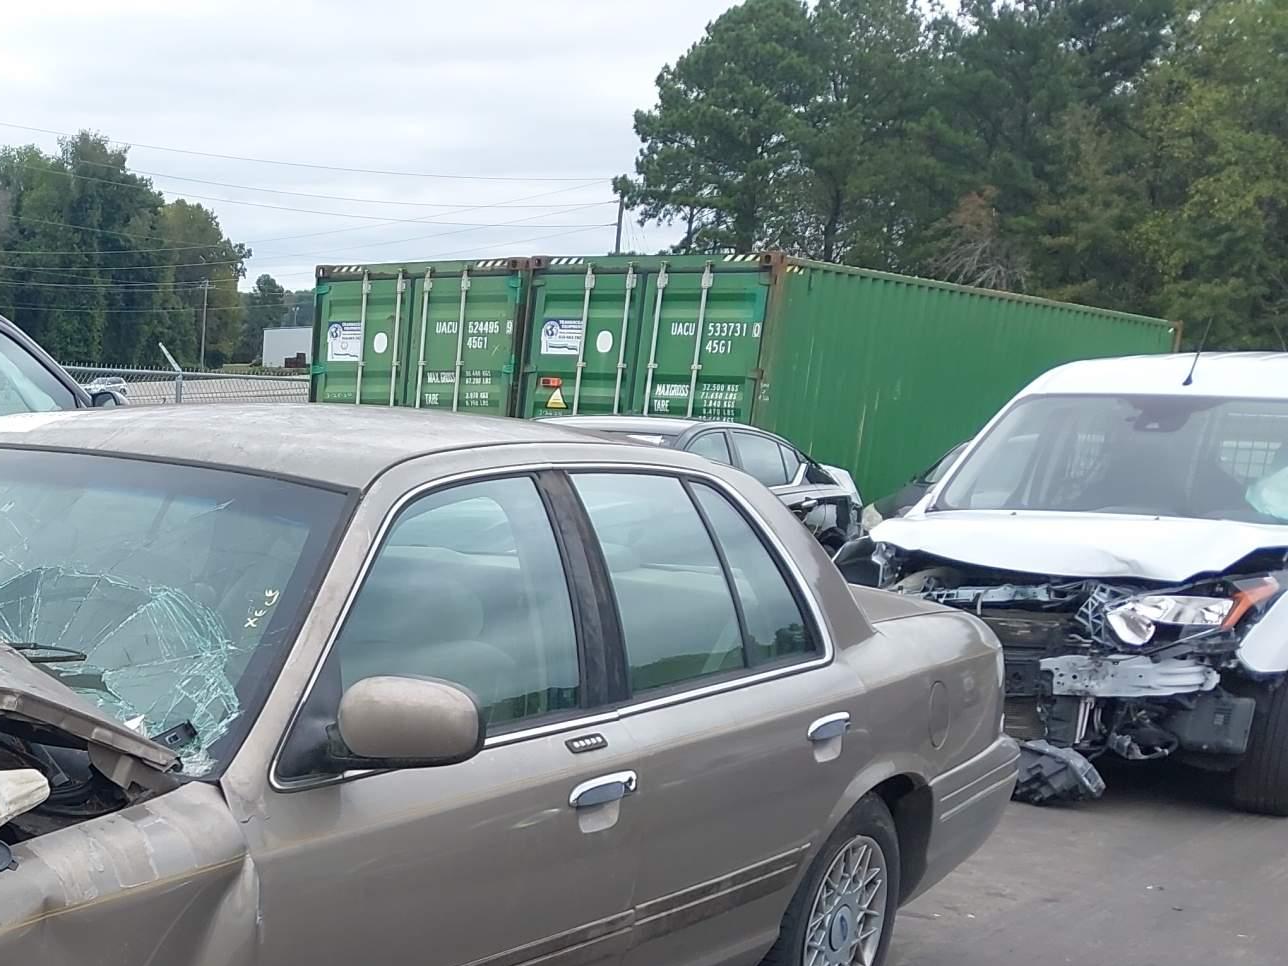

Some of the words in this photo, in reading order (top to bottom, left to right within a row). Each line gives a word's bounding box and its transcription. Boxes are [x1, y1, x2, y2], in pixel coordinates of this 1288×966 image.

[435, 321, 458, 334] UACU
[671, 322, 696, 336] UACU
[707, 322, 747, 337] 533731
[467, 336, 488, 349] 45G1
[705, 340, 733, 354] 45G1
[654, 399, 670, 412] TARE
